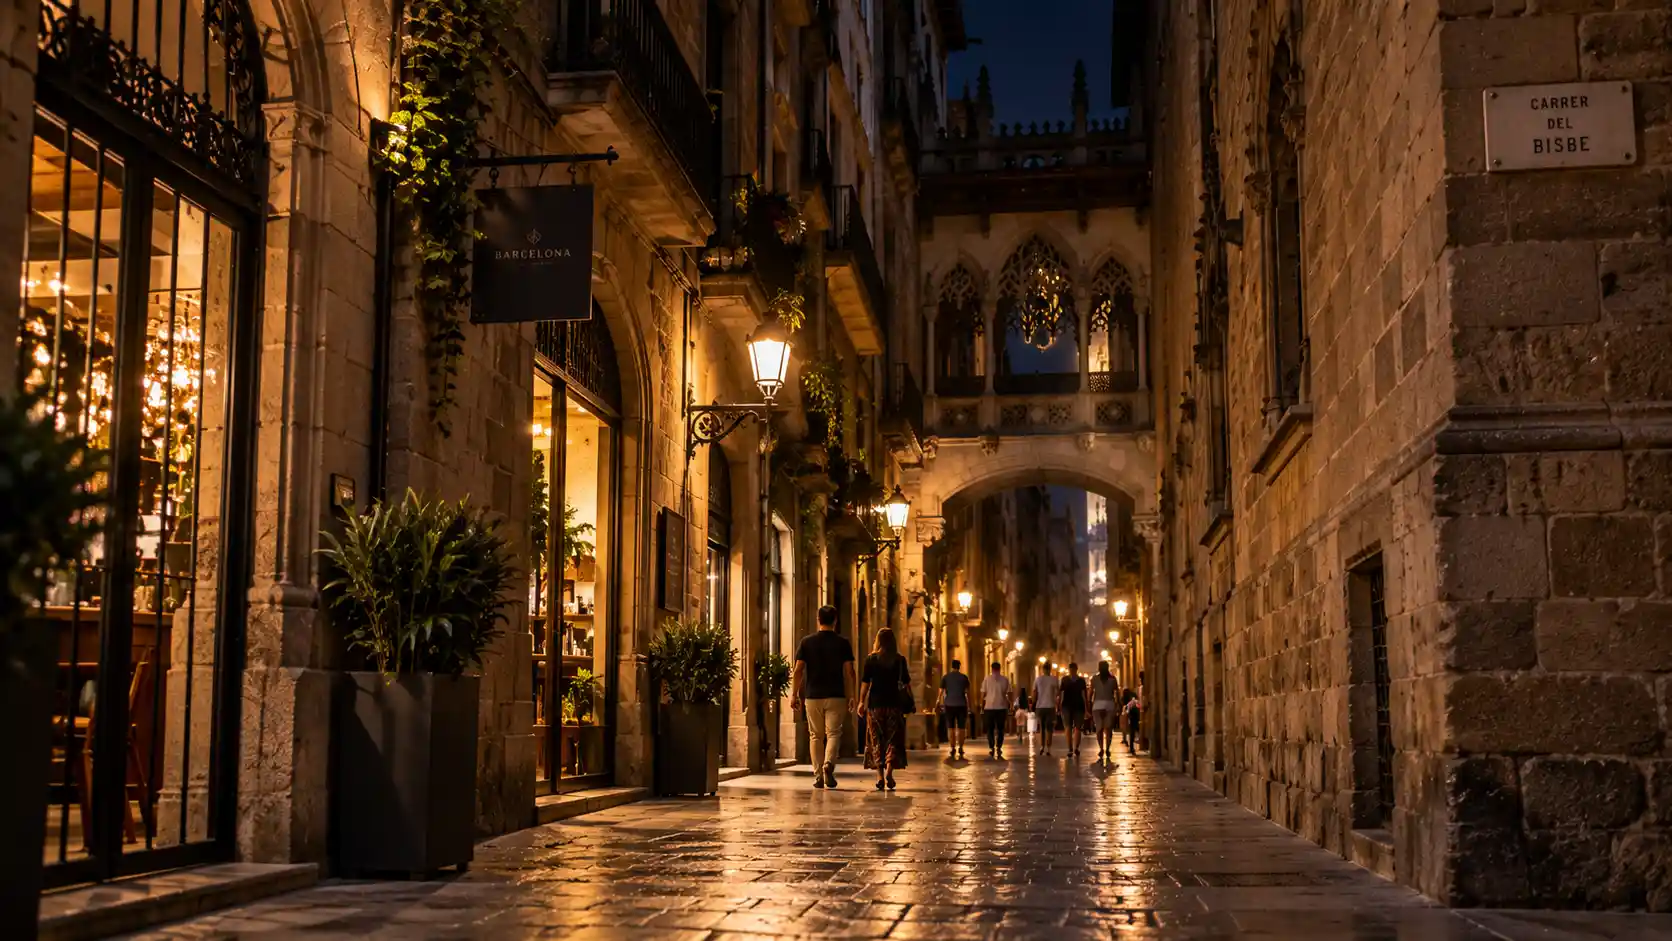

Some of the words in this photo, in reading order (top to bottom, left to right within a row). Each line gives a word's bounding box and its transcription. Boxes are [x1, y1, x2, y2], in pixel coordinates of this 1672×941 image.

[1530, 95, 1589, 110] CARRER
[1547, 117, 1574, 130] DEL
[1533, 136, 1590, 154] BISBE
[494, 248, 572, 260] BARCELONA
